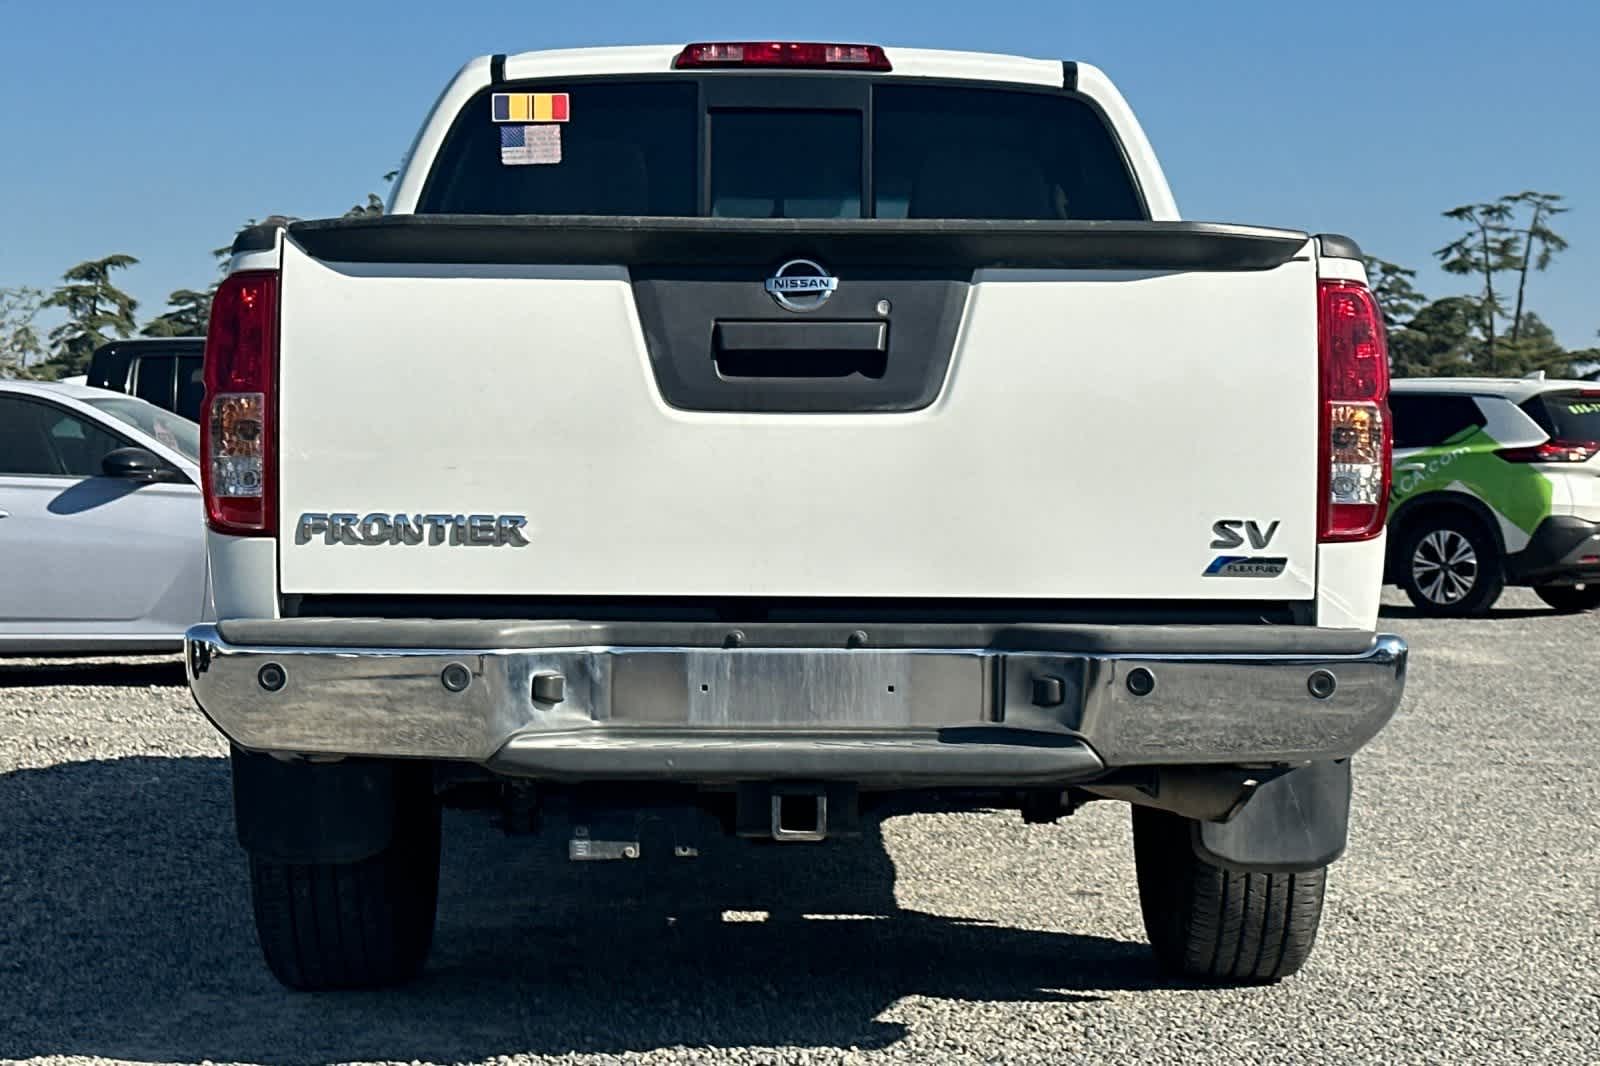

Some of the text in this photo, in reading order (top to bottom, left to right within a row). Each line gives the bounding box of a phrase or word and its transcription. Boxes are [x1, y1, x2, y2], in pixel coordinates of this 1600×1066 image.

[774, 279, 829, 288] NISSAN
[295, 513, 529, 547] FRONTIER
[1210, 520, 1280, 549] SV
[1226, 565, 1253, 573] FLEX
